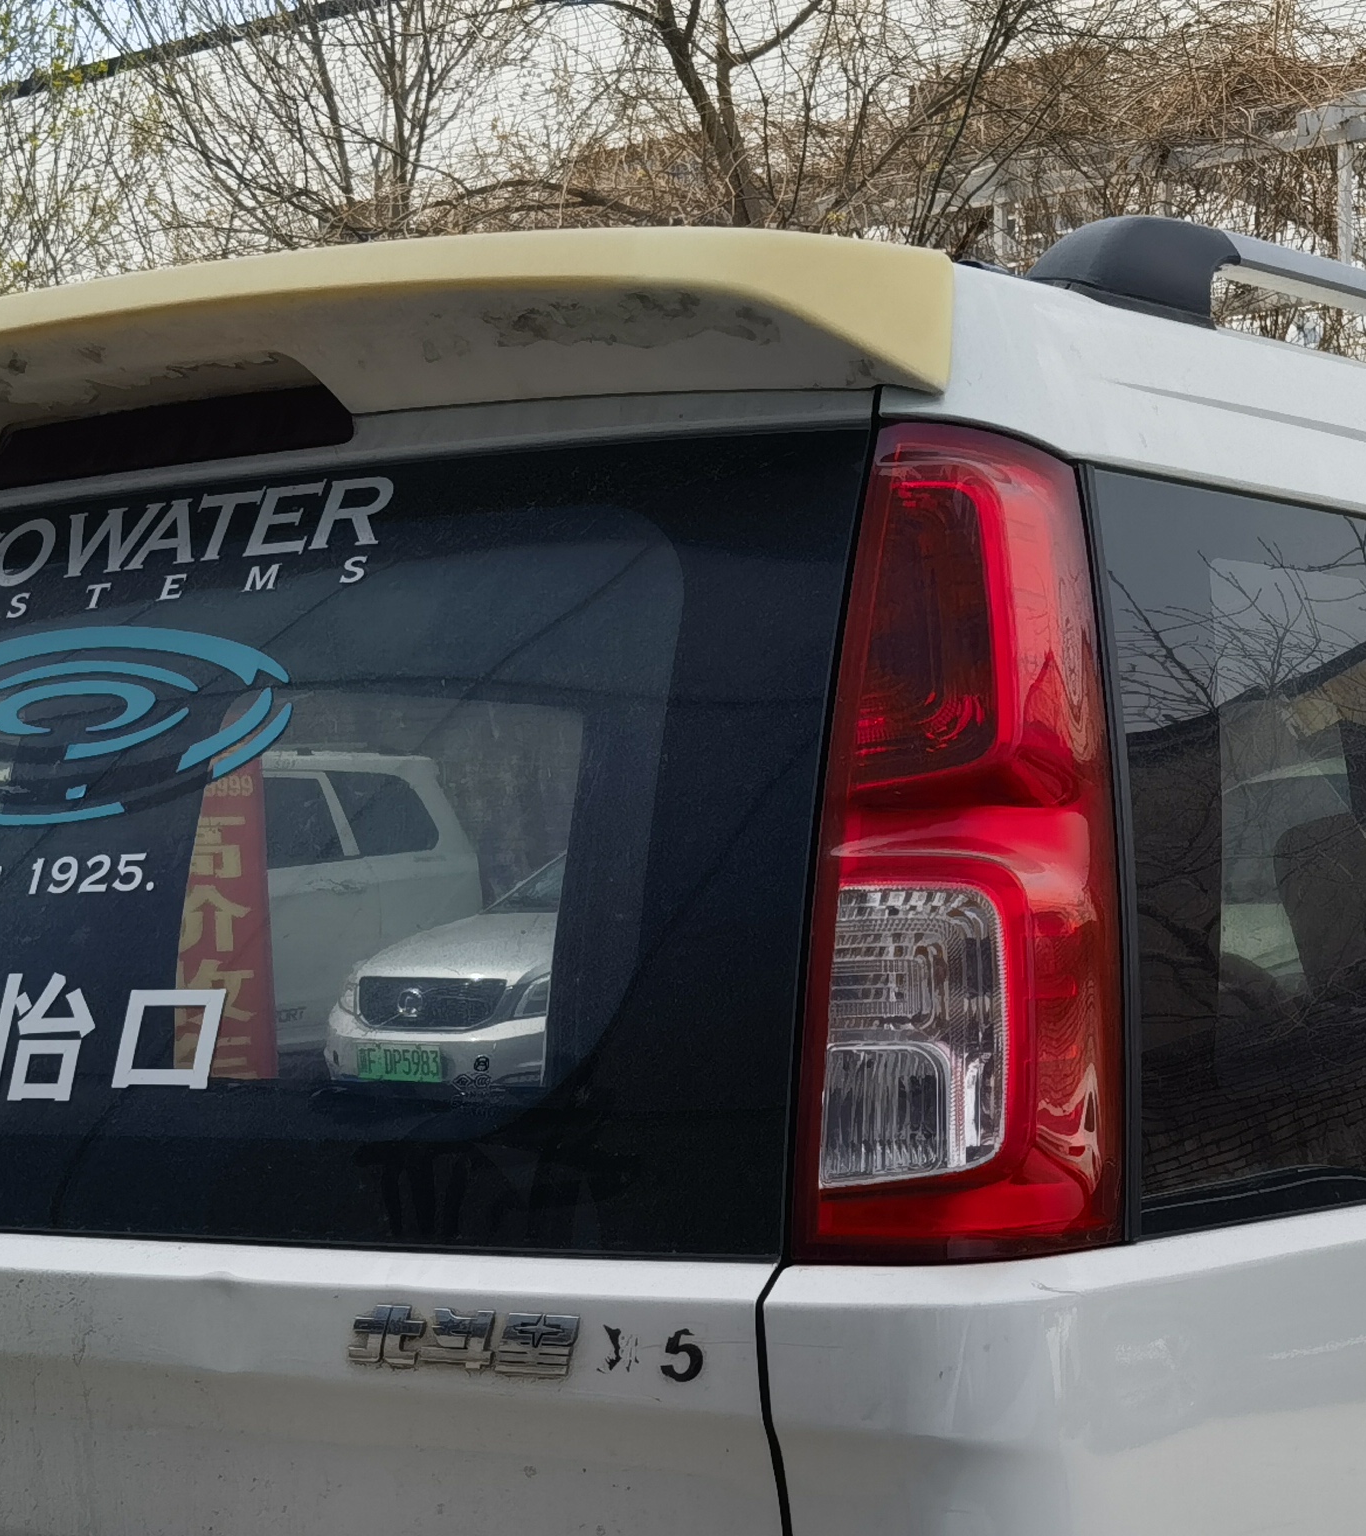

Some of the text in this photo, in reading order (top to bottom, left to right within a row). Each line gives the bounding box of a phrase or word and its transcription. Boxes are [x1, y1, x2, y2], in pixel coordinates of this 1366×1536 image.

[26, 852, 155, 896] 1925.
[347, 1303, 581, 1378] 北斗星
